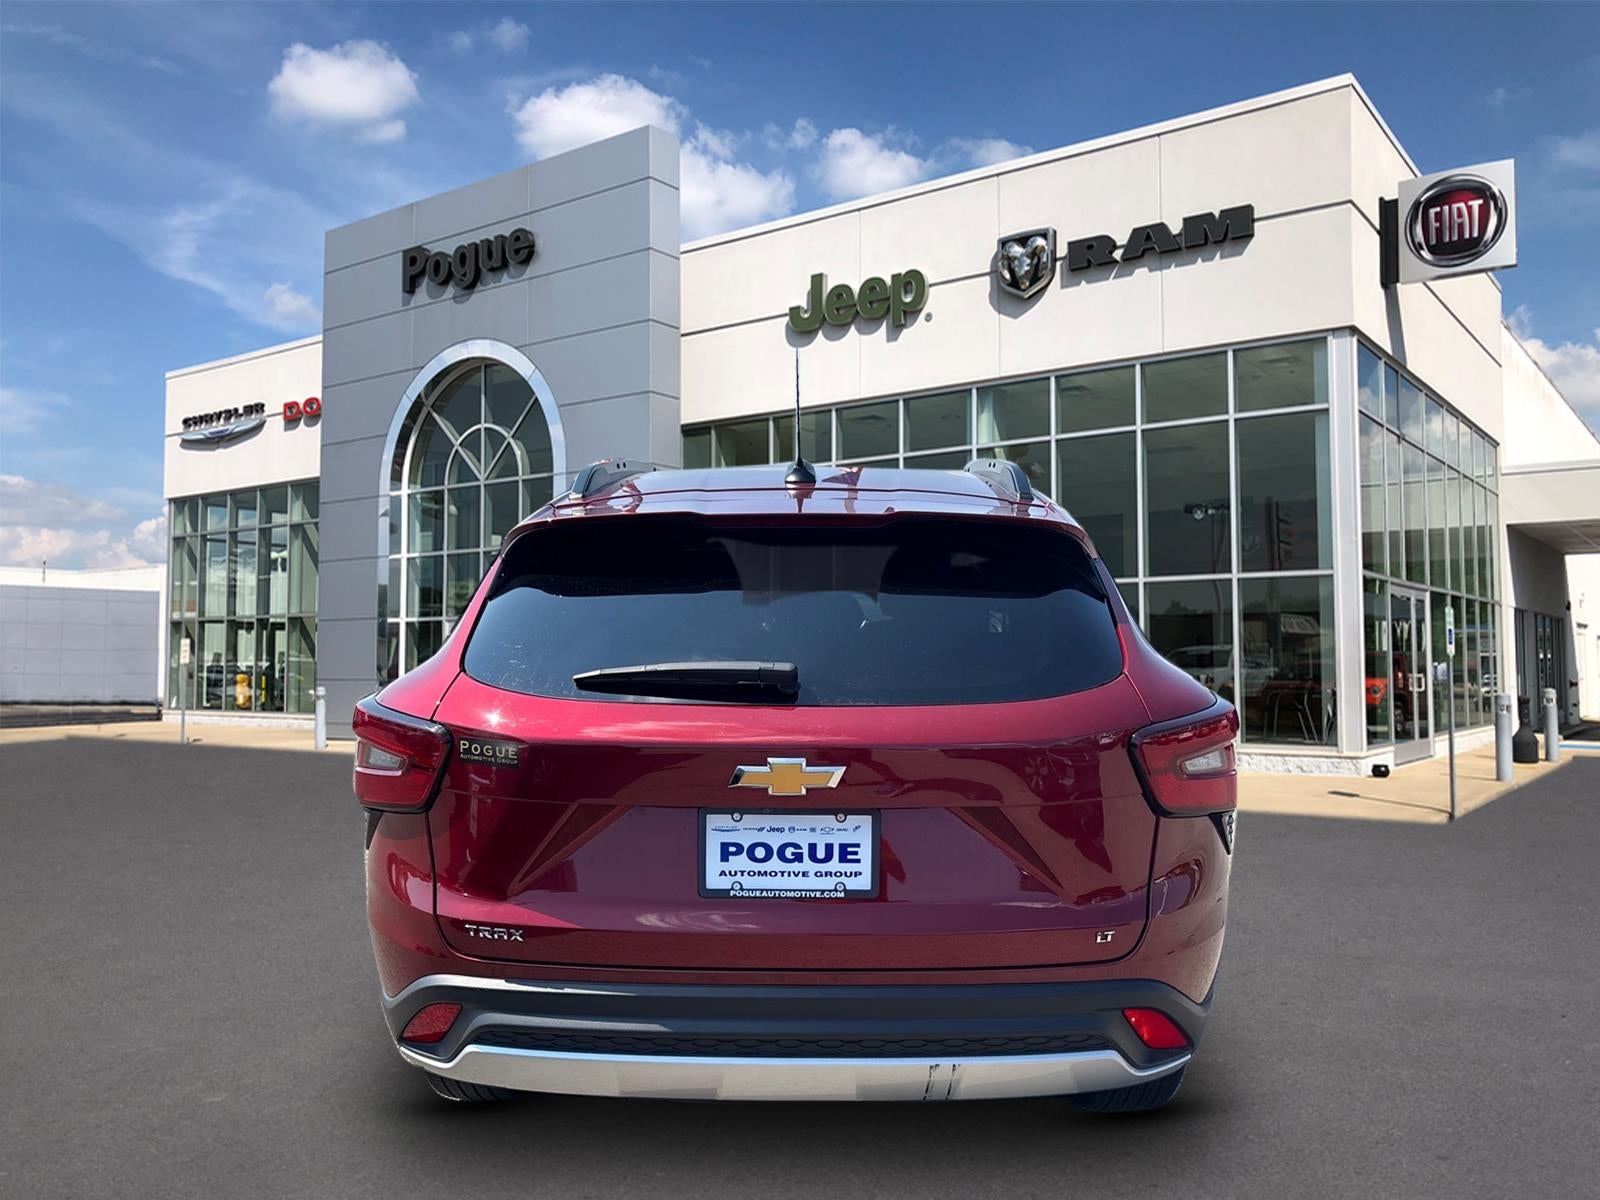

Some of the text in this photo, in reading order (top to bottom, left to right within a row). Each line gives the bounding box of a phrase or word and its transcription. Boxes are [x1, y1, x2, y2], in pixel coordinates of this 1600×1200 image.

[1428, 199, 1484, 246] FIAT
[1067, 203, 1255, 272] RAM
[402, 228, 535, 294] Pogue
[789, 268, 929, 333] Jeep
[182, 402, 266, 429] CHRYSLER
[460, 740, 518, 759] POGUE
[496, 757, 518, 765] GROUP
[766, 826, 786, 834] Jeep
[719, 841, 862, 864] POGUE
[718, 869, 863, 878] AUTOMOTIVE GROUP
[729, 889, 845, 898] POGUEAUTOMOTIVE.COM
[464, 924, 524, 942] TRAX
[1096, 930, 1116, 943] LT
